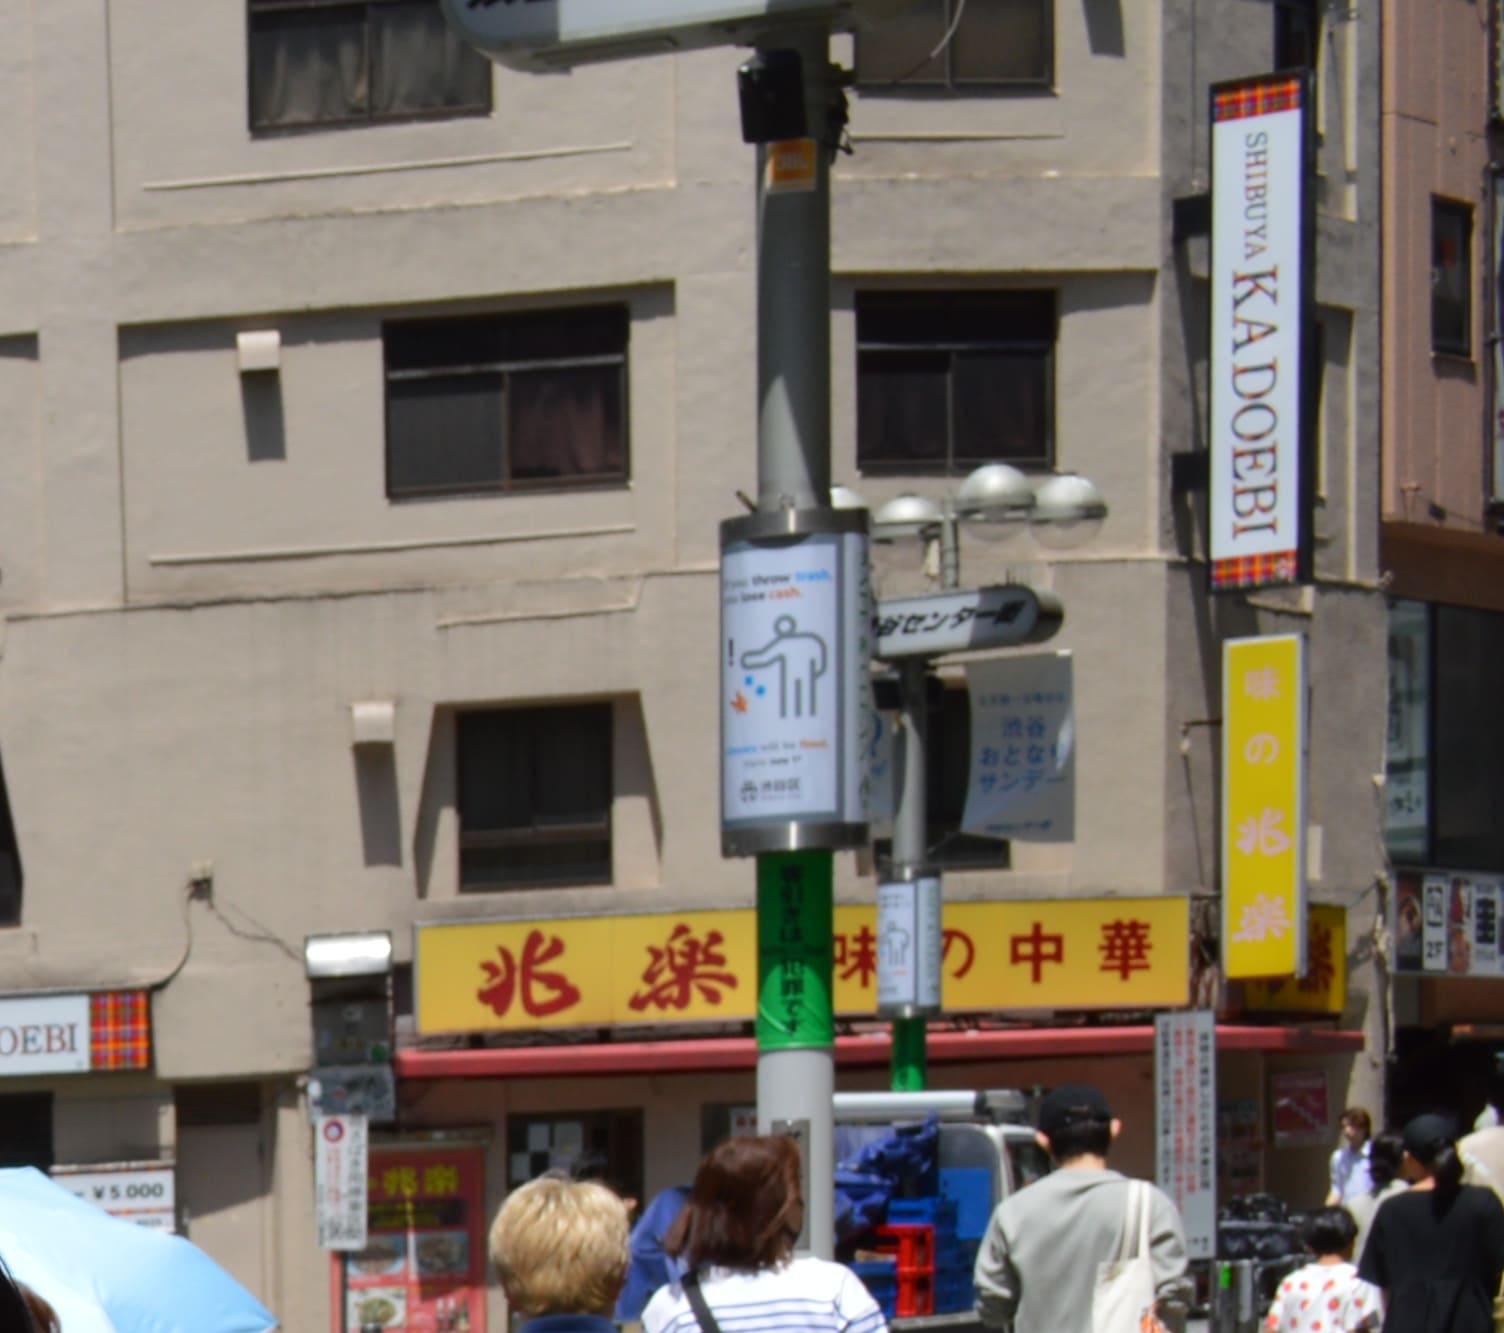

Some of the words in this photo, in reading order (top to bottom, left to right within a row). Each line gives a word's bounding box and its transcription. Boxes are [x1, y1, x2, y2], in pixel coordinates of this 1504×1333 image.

[1243, 131, 1269, 262] SHIBUYA
[1230, 269, 1279, 540] KADOEBI
[1001, 716, 1046, 740] 渋谷
[1231, 665, 1293, 944] 味の兆楽
[477, 923, 738, 1018] 兆楽
